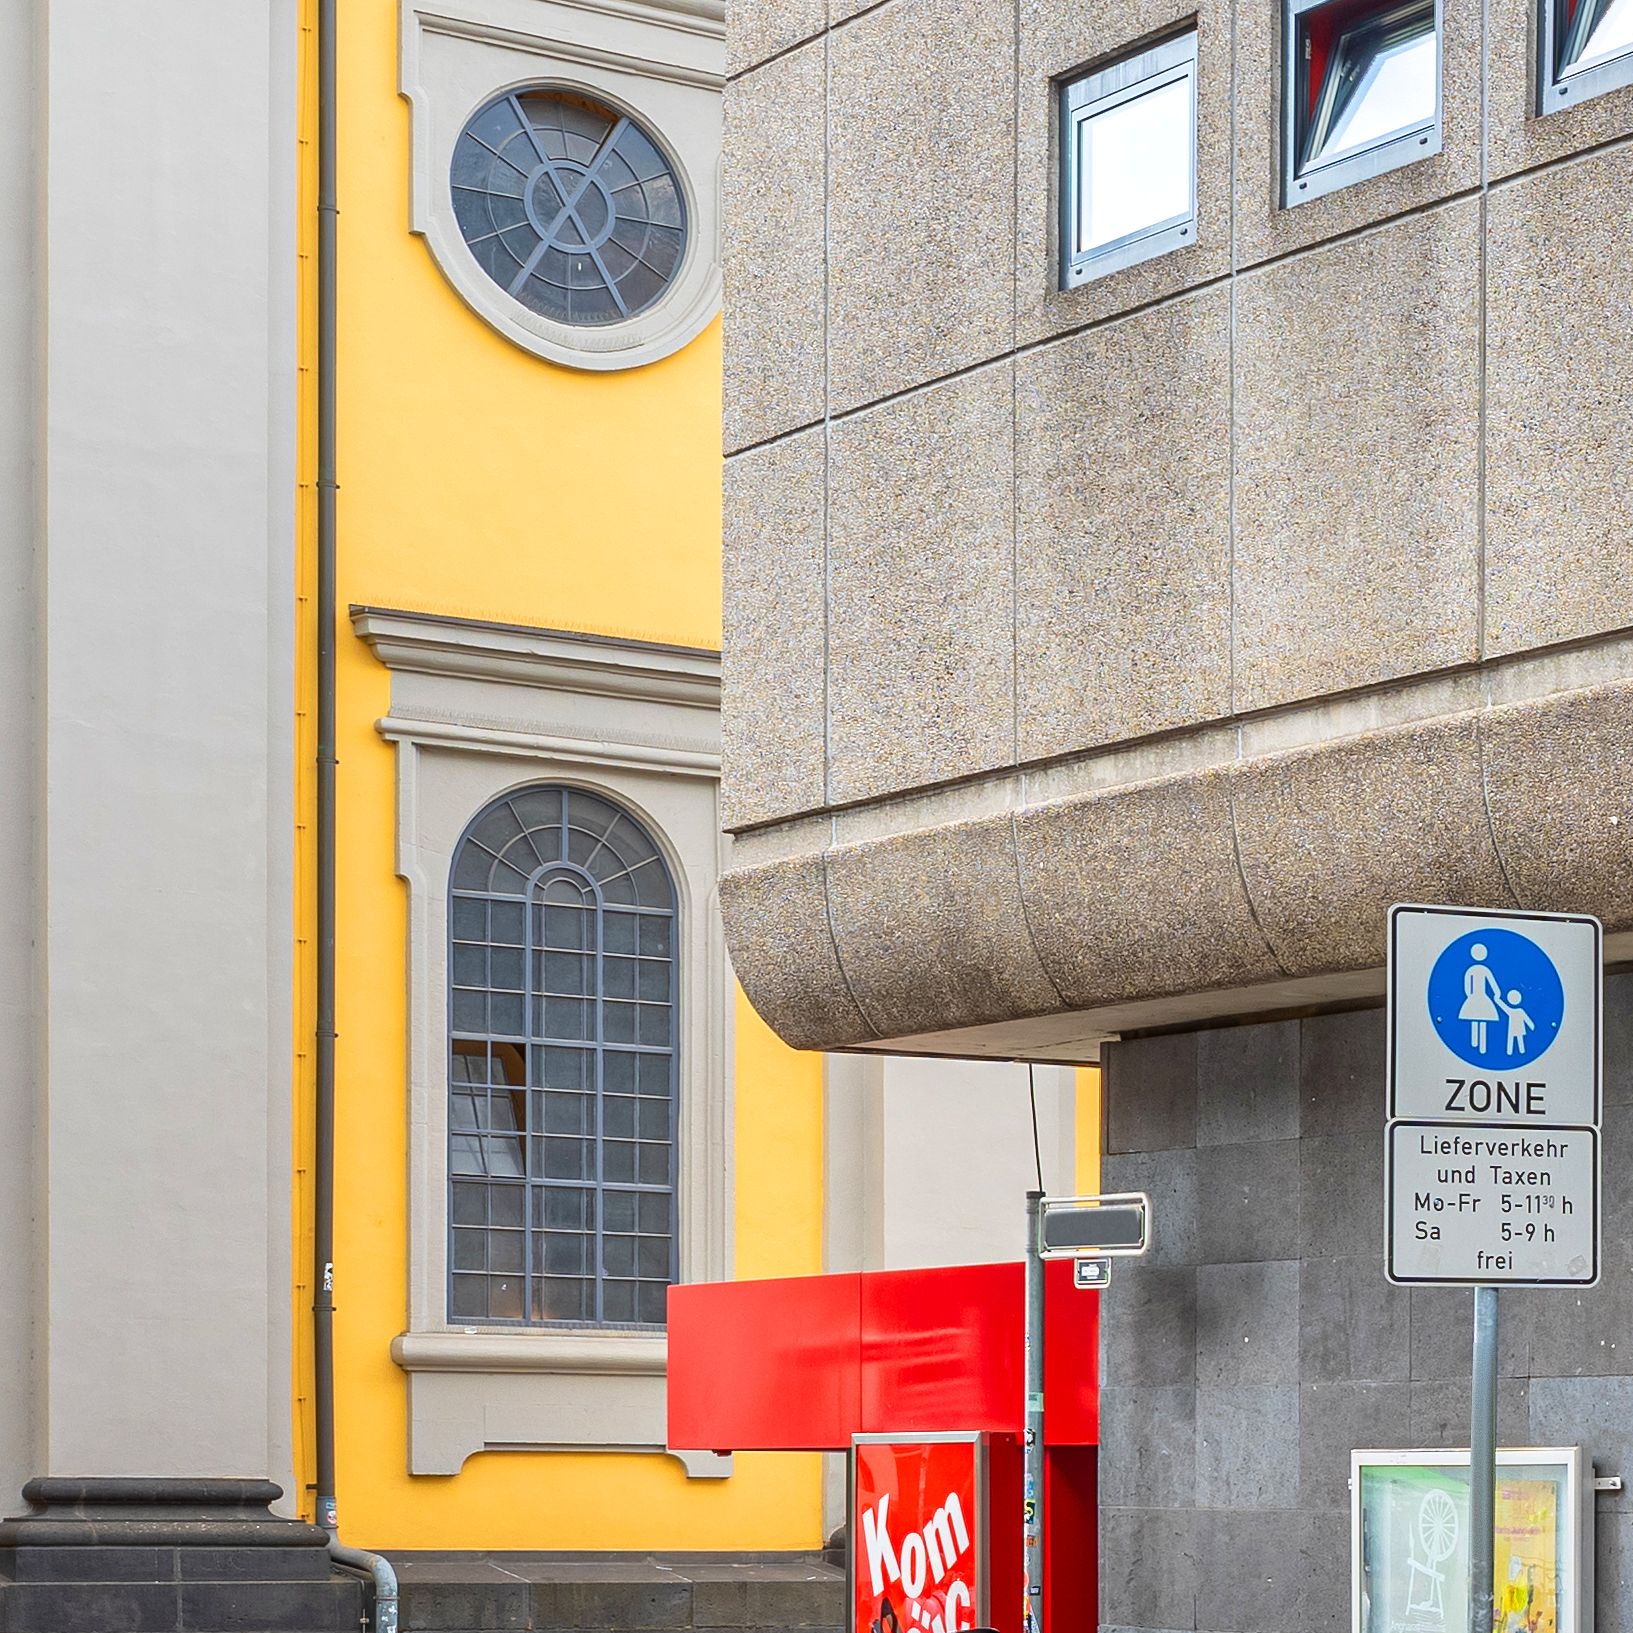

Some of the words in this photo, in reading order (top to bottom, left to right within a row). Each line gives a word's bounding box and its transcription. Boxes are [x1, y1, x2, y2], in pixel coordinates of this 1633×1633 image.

[1444, 1078, 1547, 1115] ZONE
[1420, 1135, 1568, 1158] Lieferverkehr
[1437, 1165, 1475, 1183] und
[1490, 1166, 1551, 1185] Taxen
[1414, 1192, 1481, 1213] Mo-Fr
[1562, 1196, 1573, 1214] h
[1415, 1221, 1441, 1240] Sa
[1501, 1223, 1536, 1242] 5-9
[1544, 1223, 1555, 1242] h
[1477, 1251, 1513, 1270] frei
[862, 1491, 970, 1599] Kom
